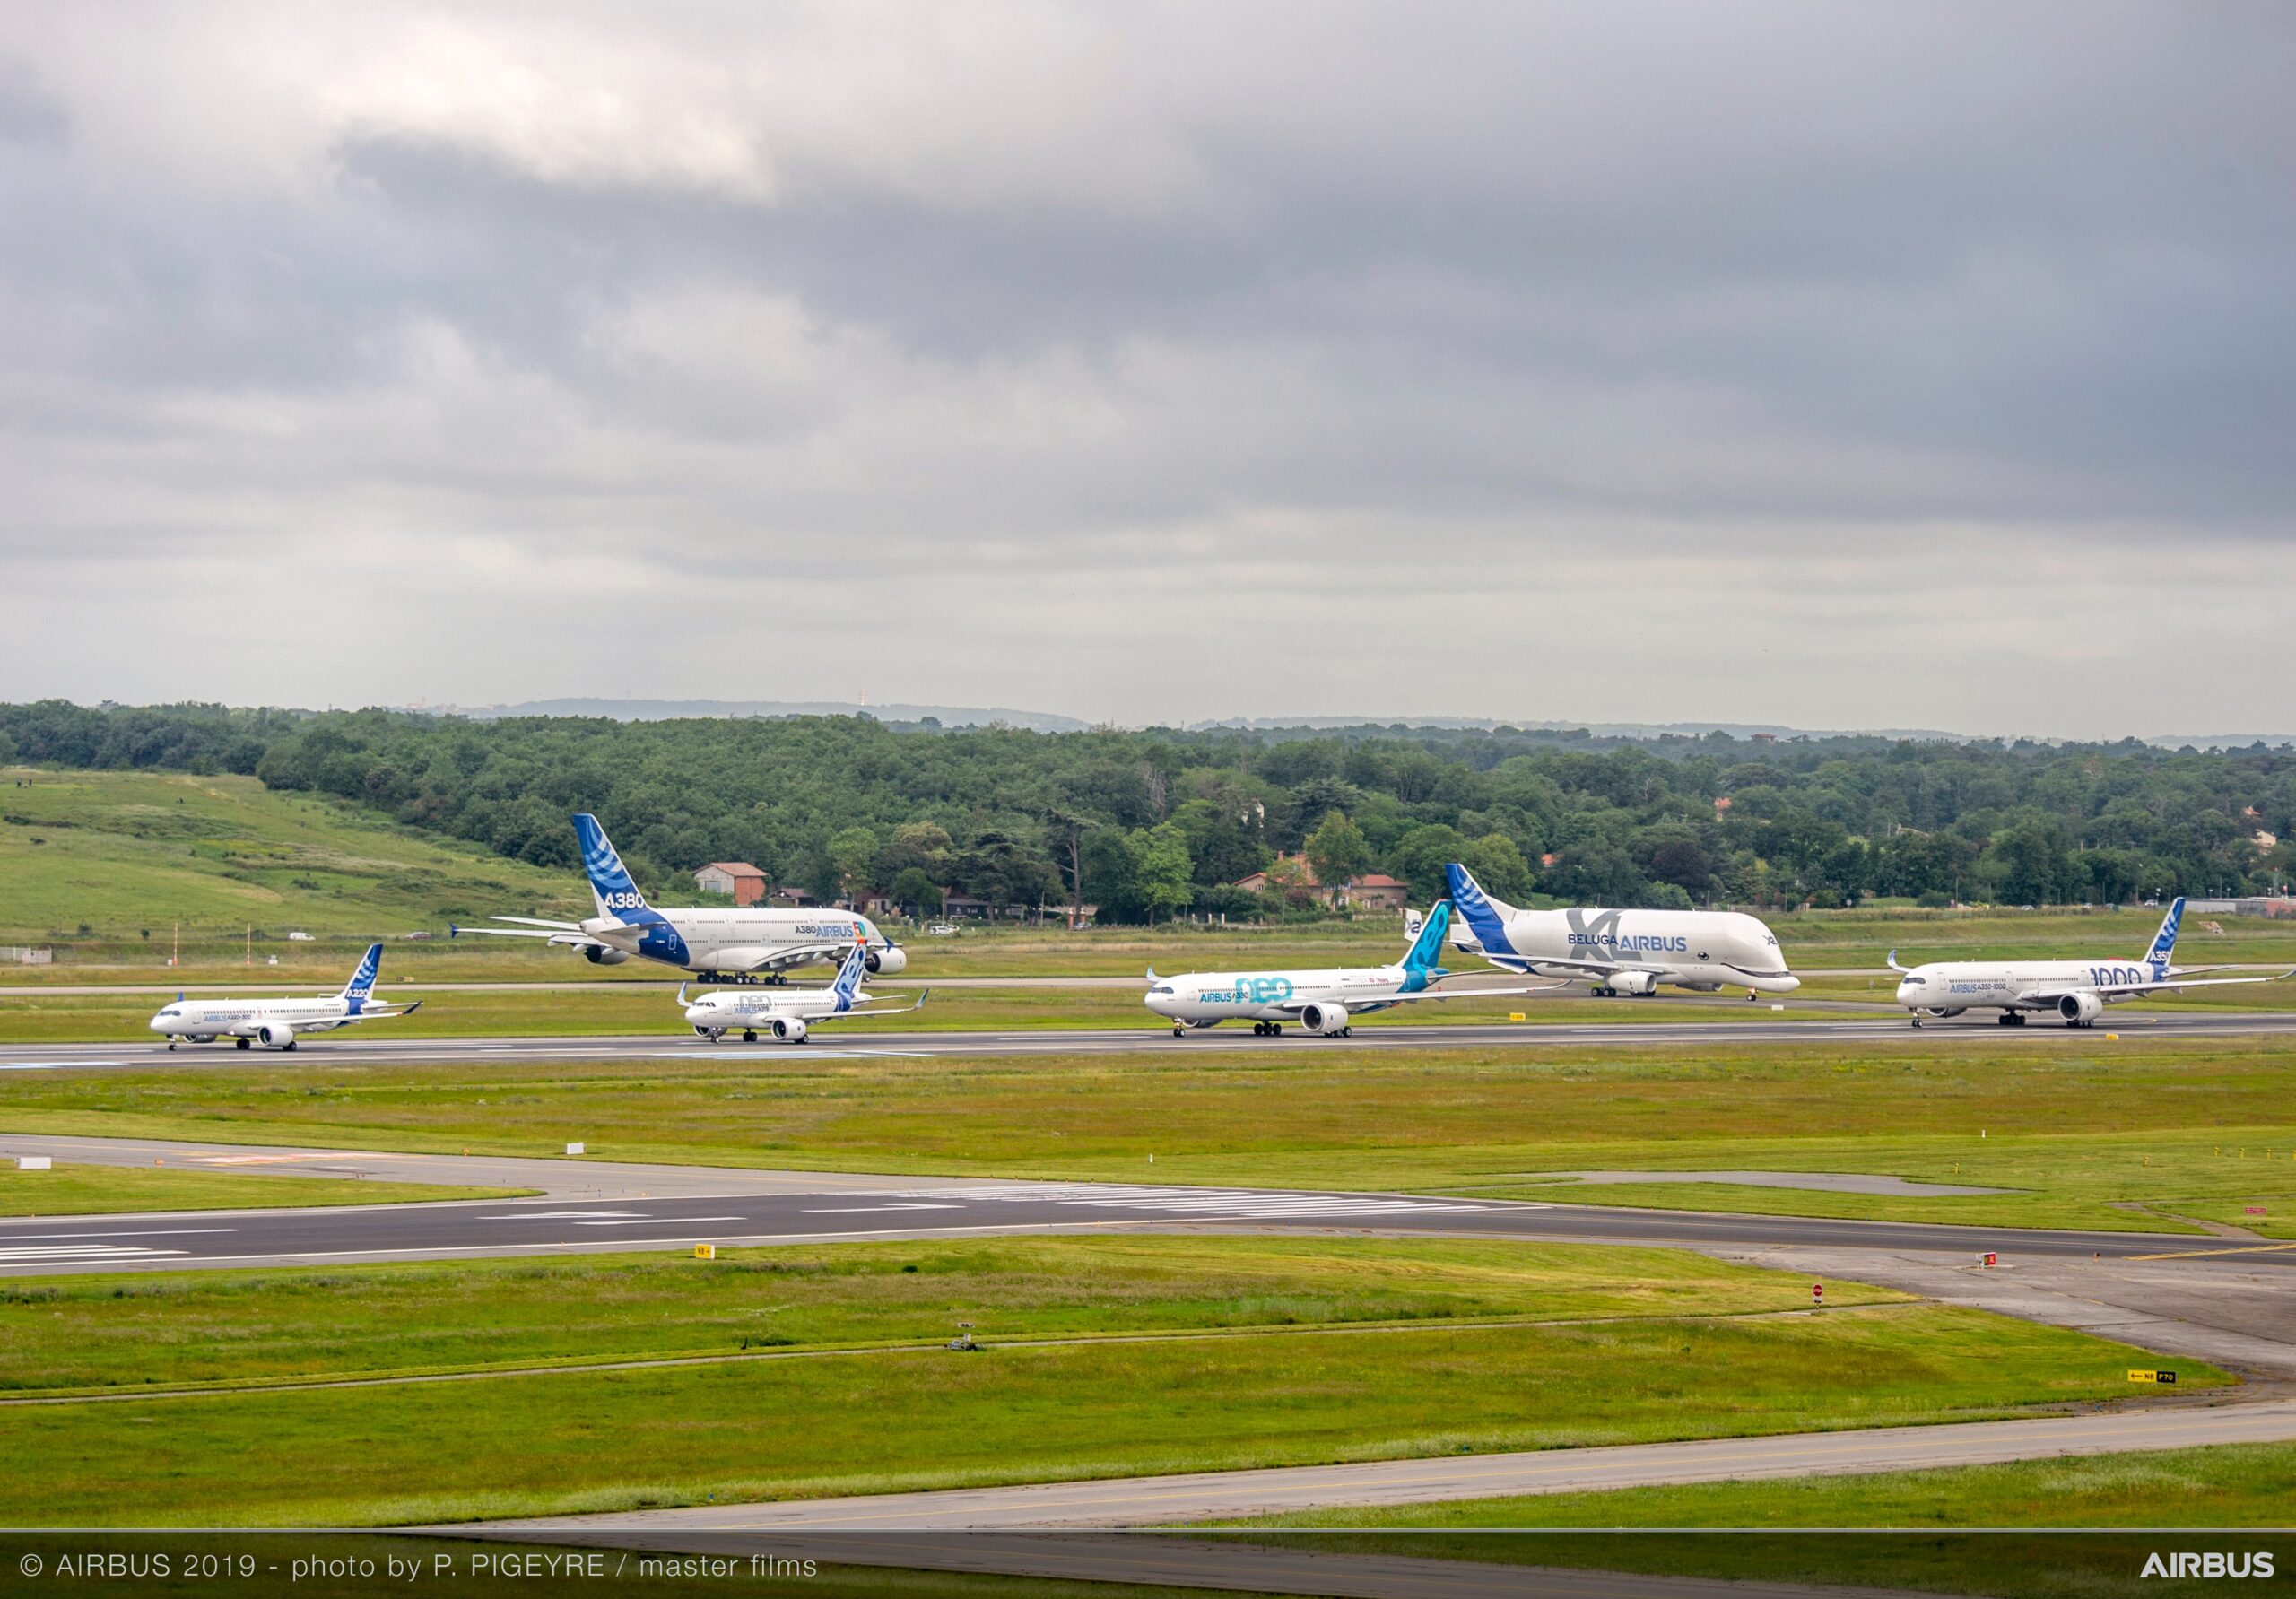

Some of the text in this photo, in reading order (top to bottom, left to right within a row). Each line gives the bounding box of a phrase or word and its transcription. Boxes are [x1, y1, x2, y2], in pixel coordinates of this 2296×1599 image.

[604, 892, 646, 909] A380
[796, 926, 816, 934] A380
[816, 926, 854, 937] AIRBUS
[1568, 934, 1687, 952] BELUGA AIRBUS
[2150, 952, 2170, 962] A350
[2090, 967, 2142, 986] 1000
[347, 988, 369, 998] A220
[1950, 983, 2006, 994] AIRBUS A350-1000
[1199, 991, 1249, 1004] AIRBUS A330
[735, 1006, 758, 1015] AIRBUS
[204, 1014, 227, 1022] AIRBUS
[2159, 1373, 2174, 1381] P70
